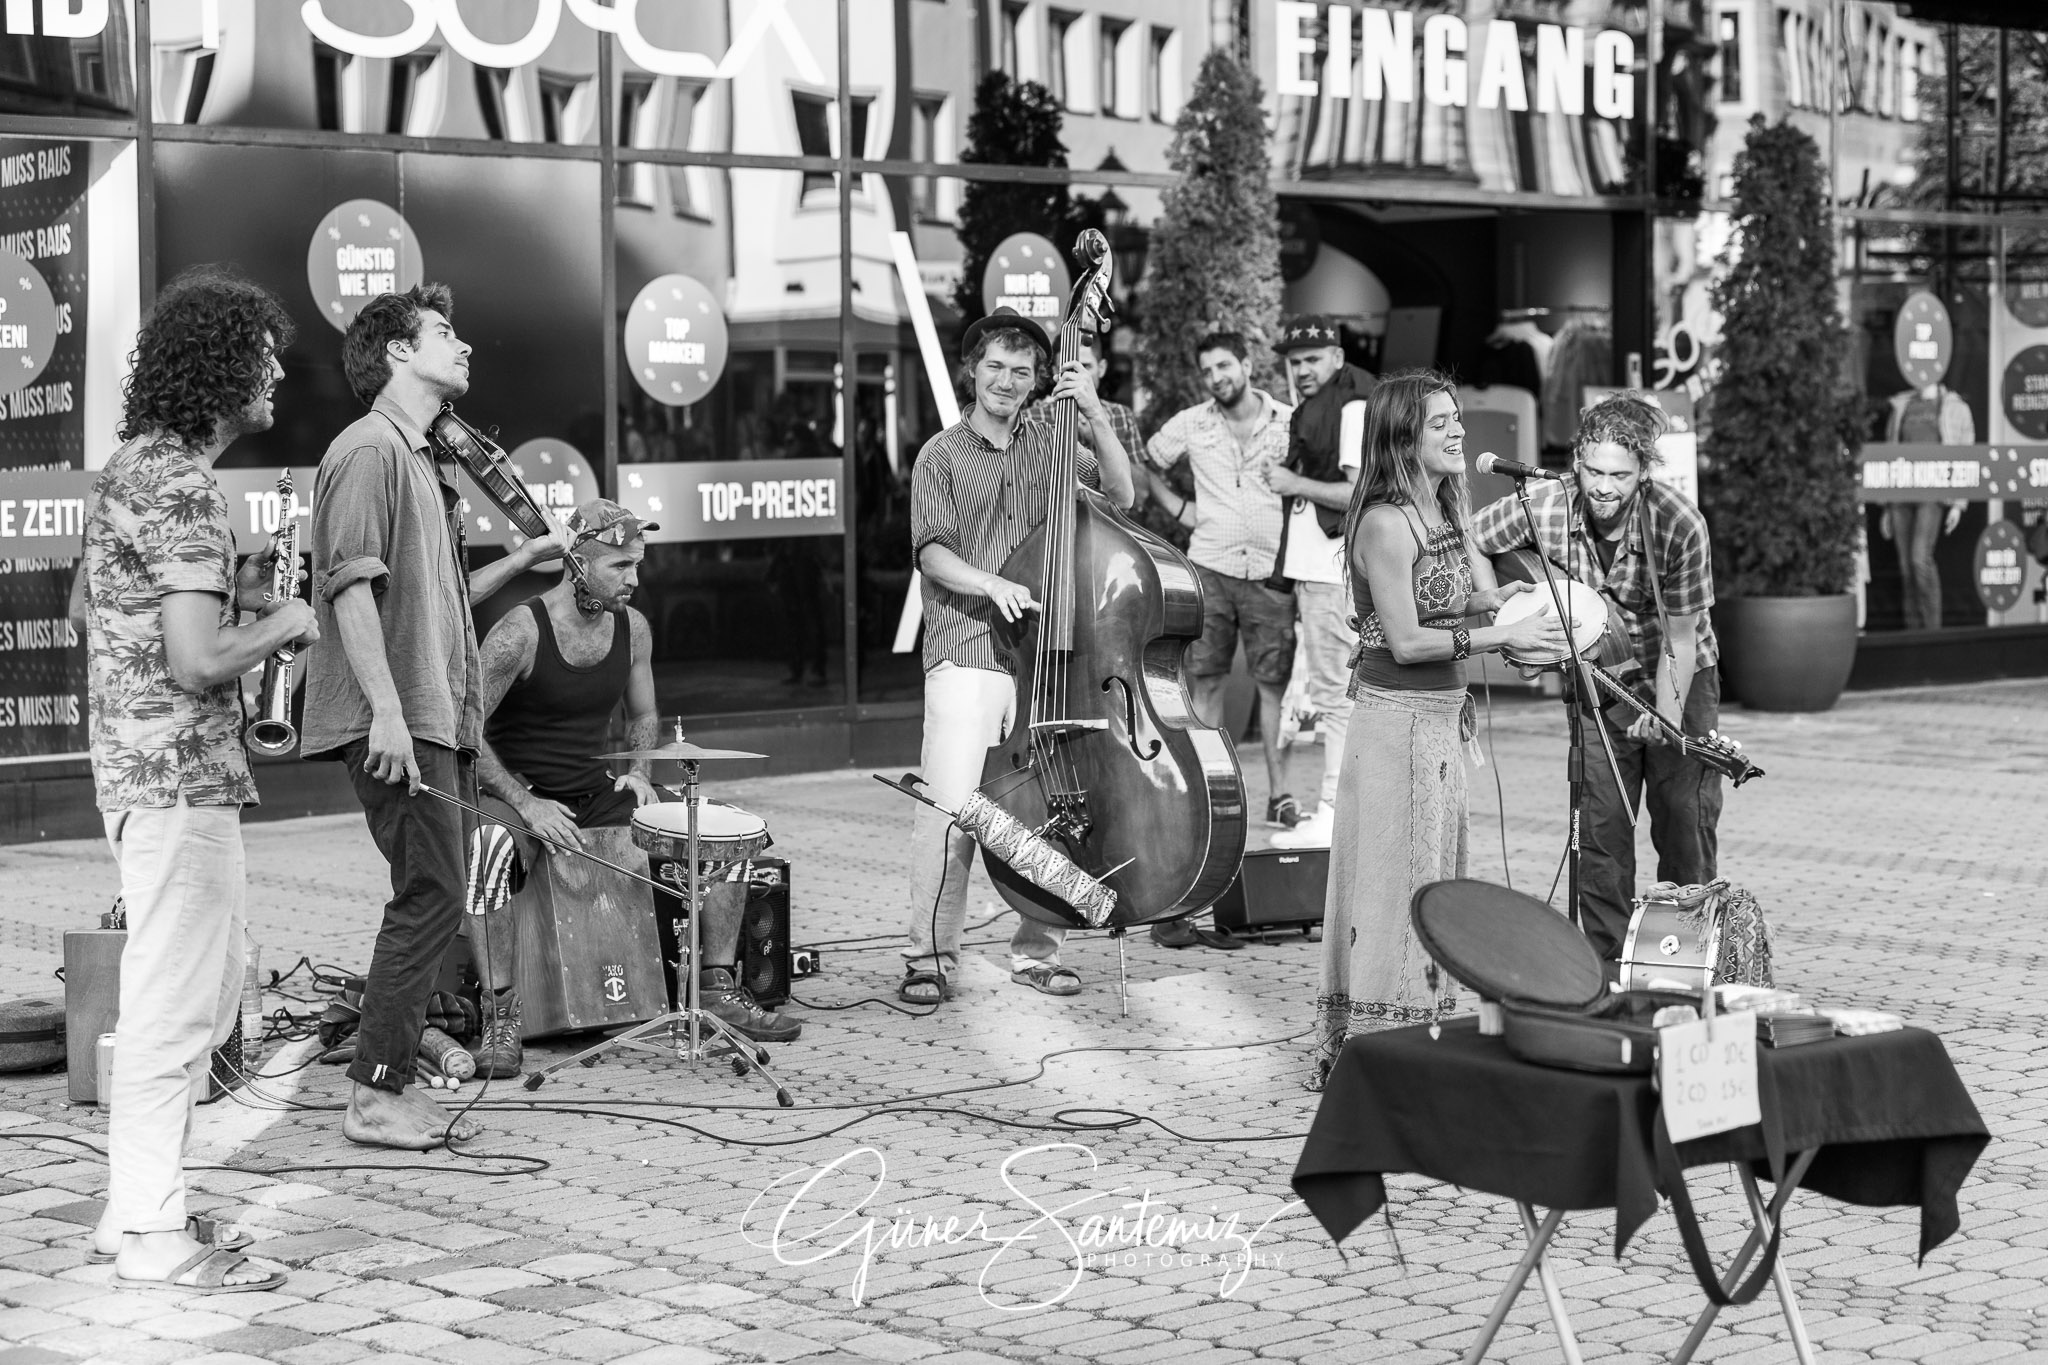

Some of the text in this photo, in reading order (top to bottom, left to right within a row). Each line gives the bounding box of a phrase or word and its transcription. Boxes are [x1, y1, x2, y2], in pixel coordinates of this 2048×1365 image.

[1276, 1, 1636, 120] EINGANG
[1, 145, 71, 188] MUSS RAUS
[37, 223, 71, 259] RAUS
[336, 244, 396, 271] GÜNSTIG
[338, 272, 367, 296] WIE
[664, 317, 690, 340] TOP
[10, 386, 45, 420] MUSS
[45, 381, 73, 415] RAUS
[1863, 457, 1980, 488] NUR FÜR KURZE ZEIT!
[698, 478, 837, 522] TOP-PREISE!
[22, 498, 85, 537] ZEIT!
[16, 618, 52, 650] MUSS
[52, 618, 79, 649] RAUS
[18, 694, 53, 726] MUSS
[54, 694, 80, 726] RAUS
[1689, 1042, 1709, 1065] CD
[1688, 1082, 1707, 1103] CD
